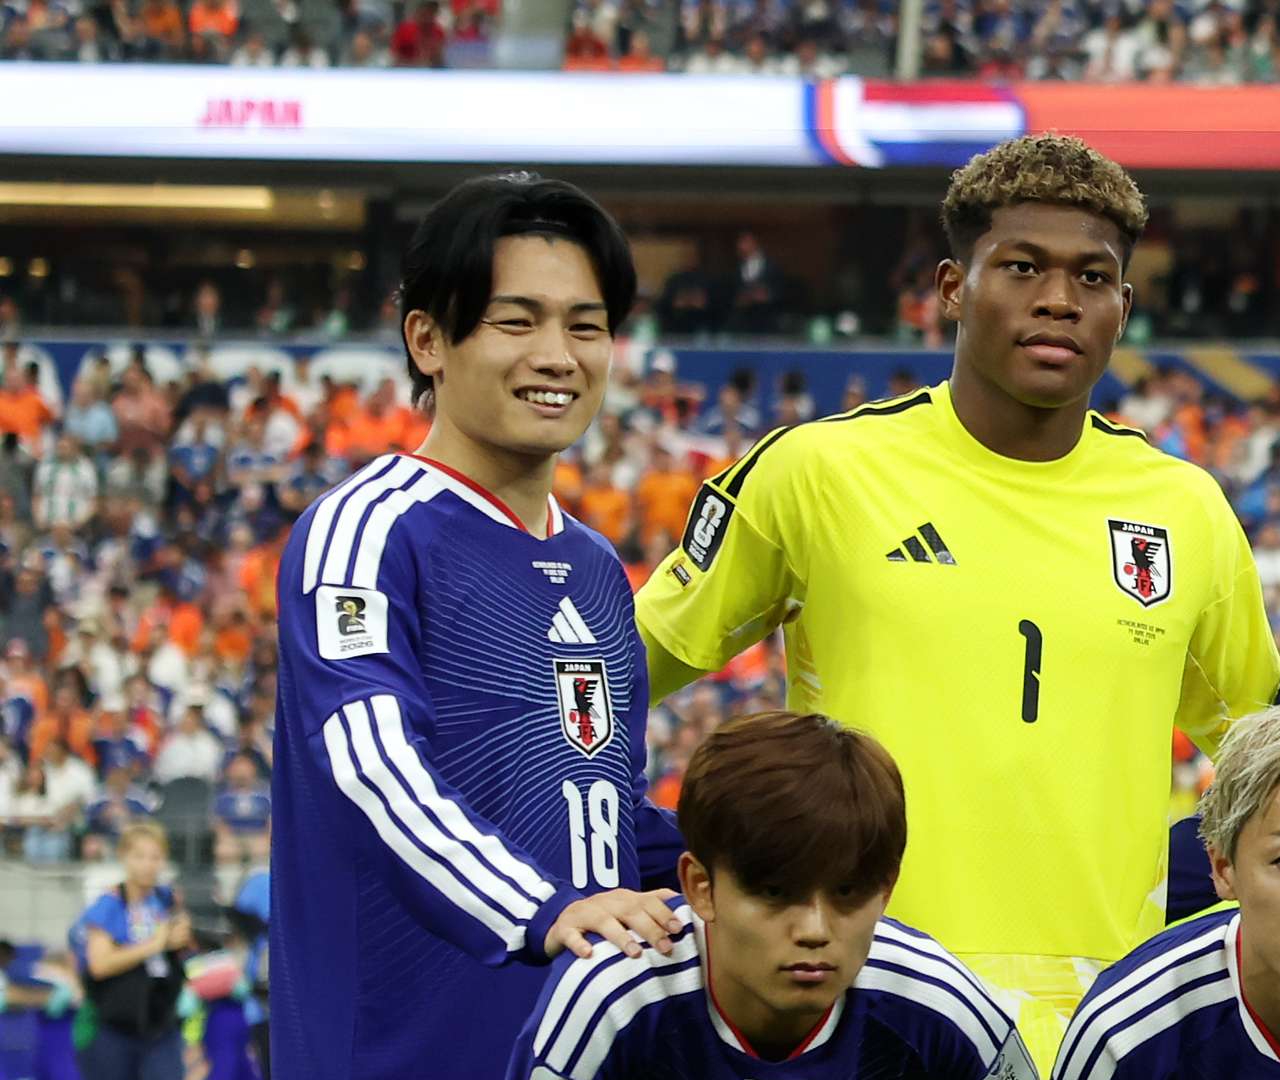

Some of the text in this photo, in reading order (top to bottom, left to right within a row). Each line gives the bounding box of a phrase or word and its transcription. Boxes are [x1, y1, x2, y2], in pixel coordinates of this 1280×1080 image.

[198, 98, 302, 127] JAPAN
[1122, 523, 1154, 536] JAPAN
[564, 664, 592, 672] JAPAN
[1018, 619, 1042, 724] 1
[562, 780, 620, 889] 18
